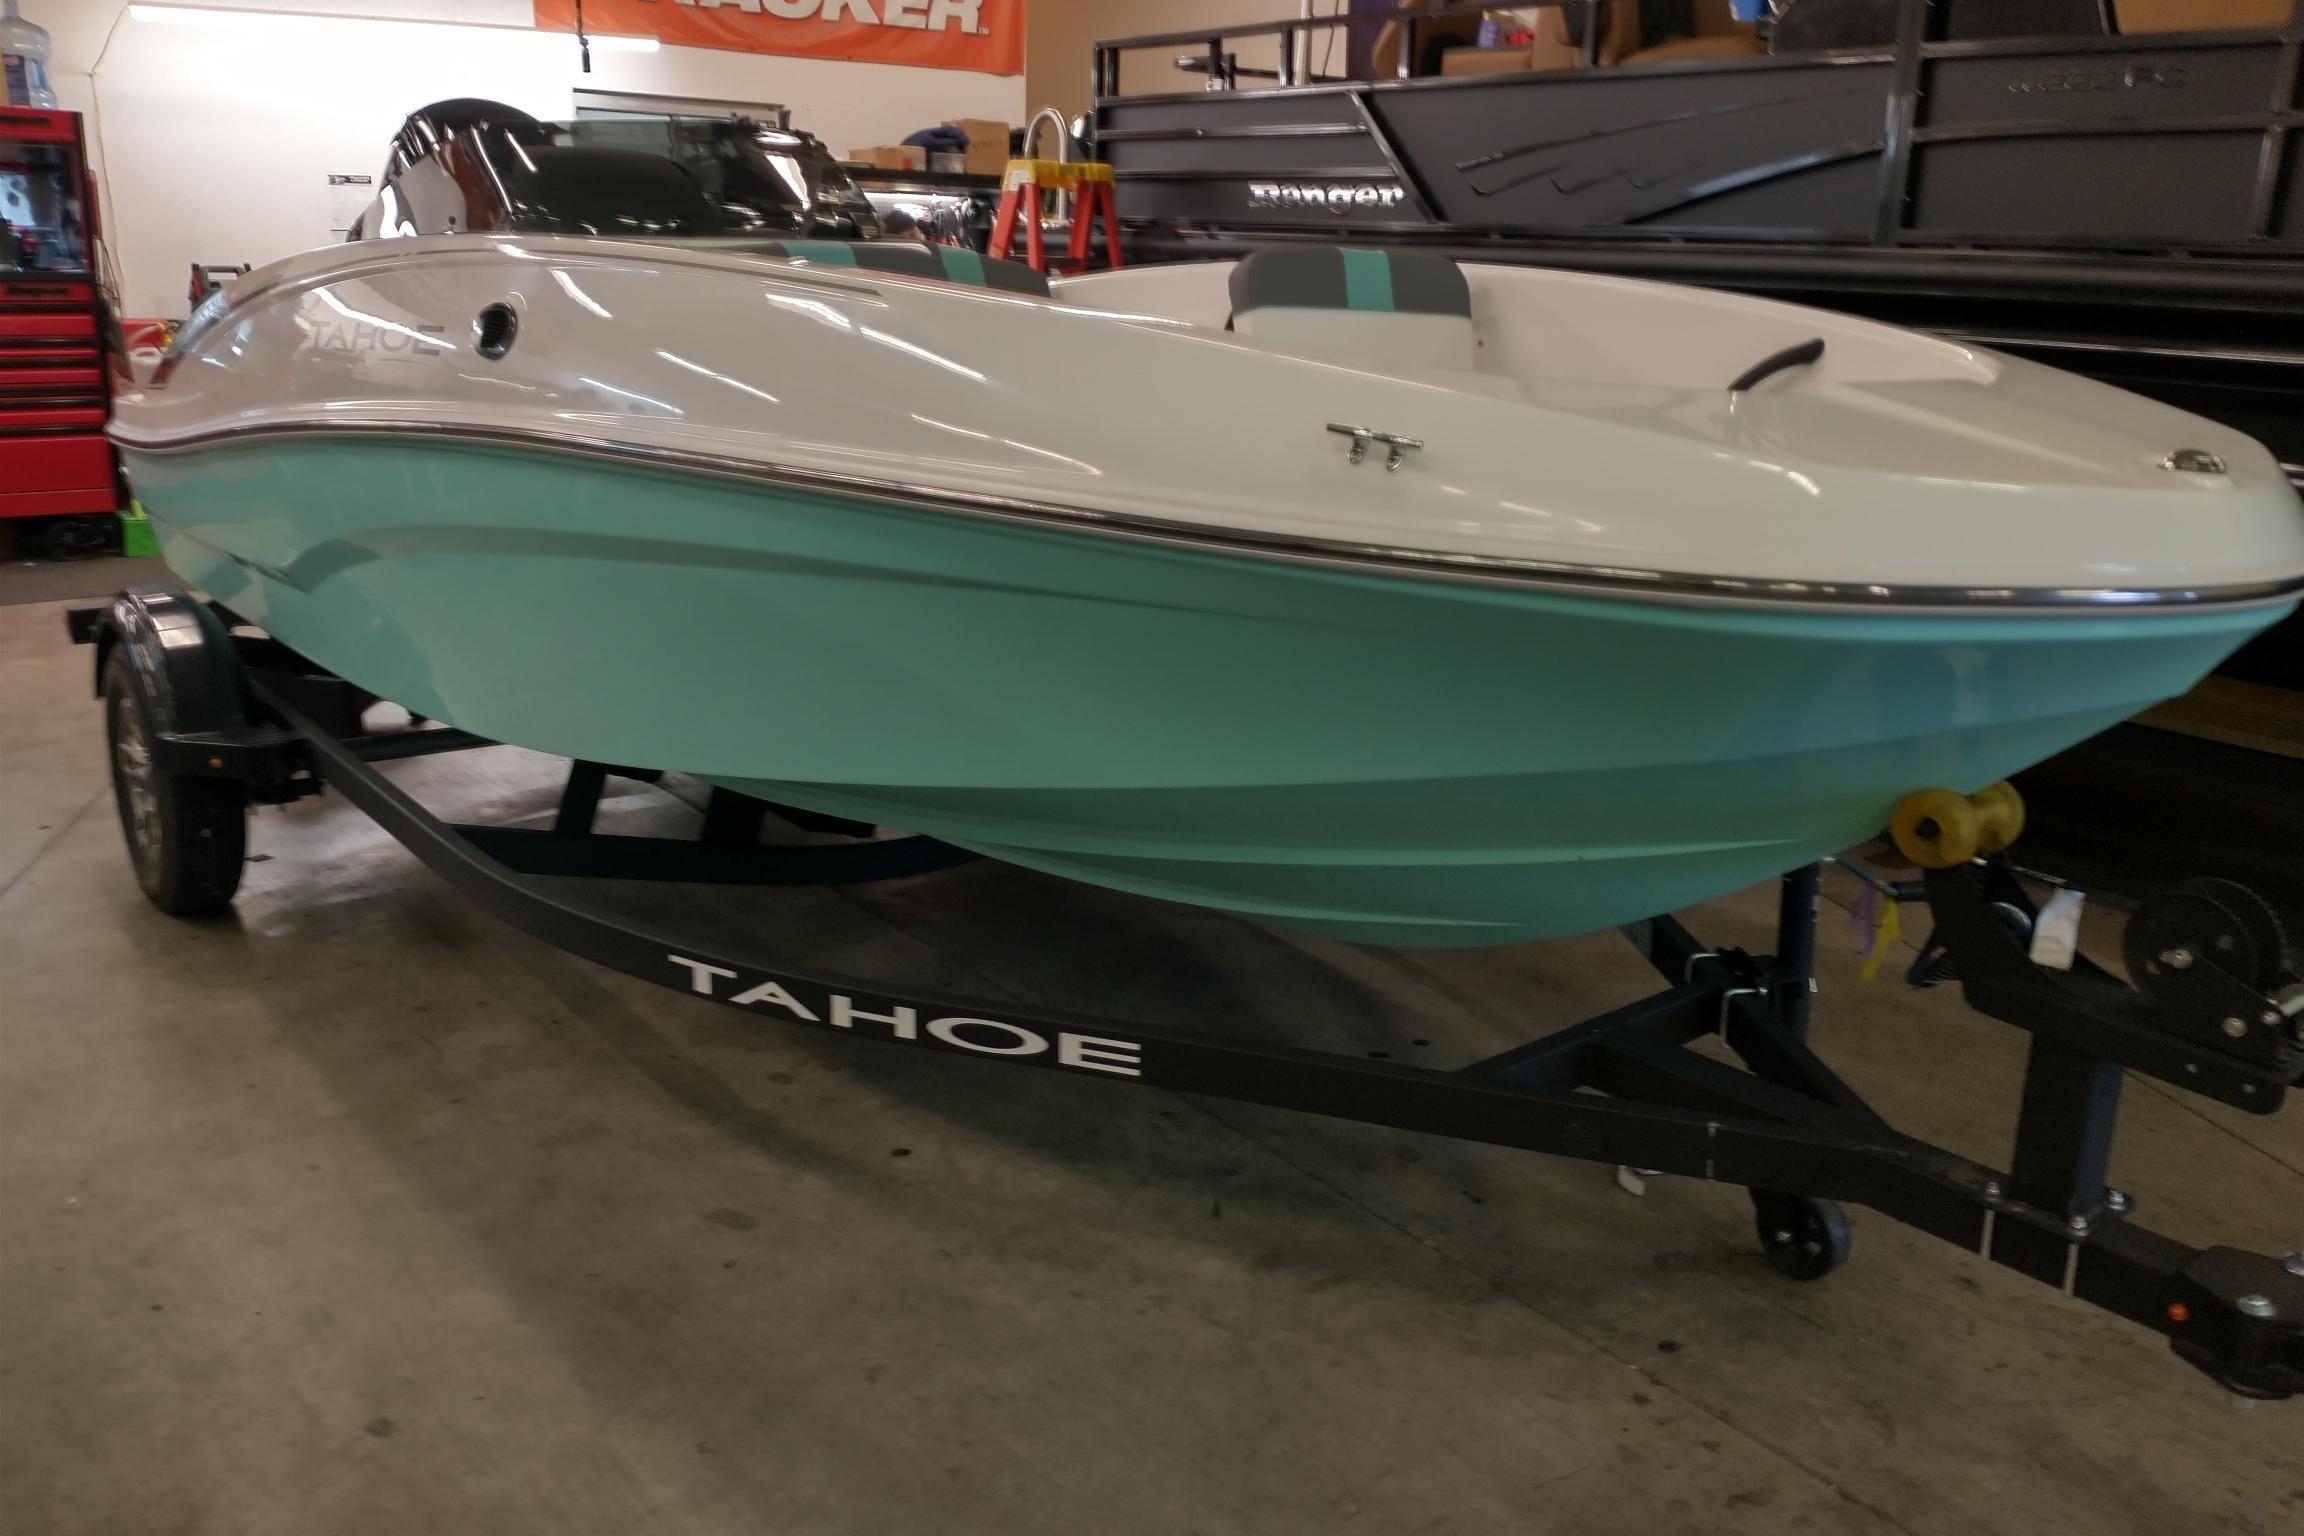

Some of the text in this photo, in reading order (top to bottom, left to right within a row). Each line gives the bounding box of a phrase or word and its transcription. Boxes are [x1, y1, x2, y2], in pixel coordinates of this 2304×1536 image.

[1248, 180, 1405, 215] Ranger
[308, 320, 446, 356] TAHOE
[667, 954, 1142, 1077] TAHOE
